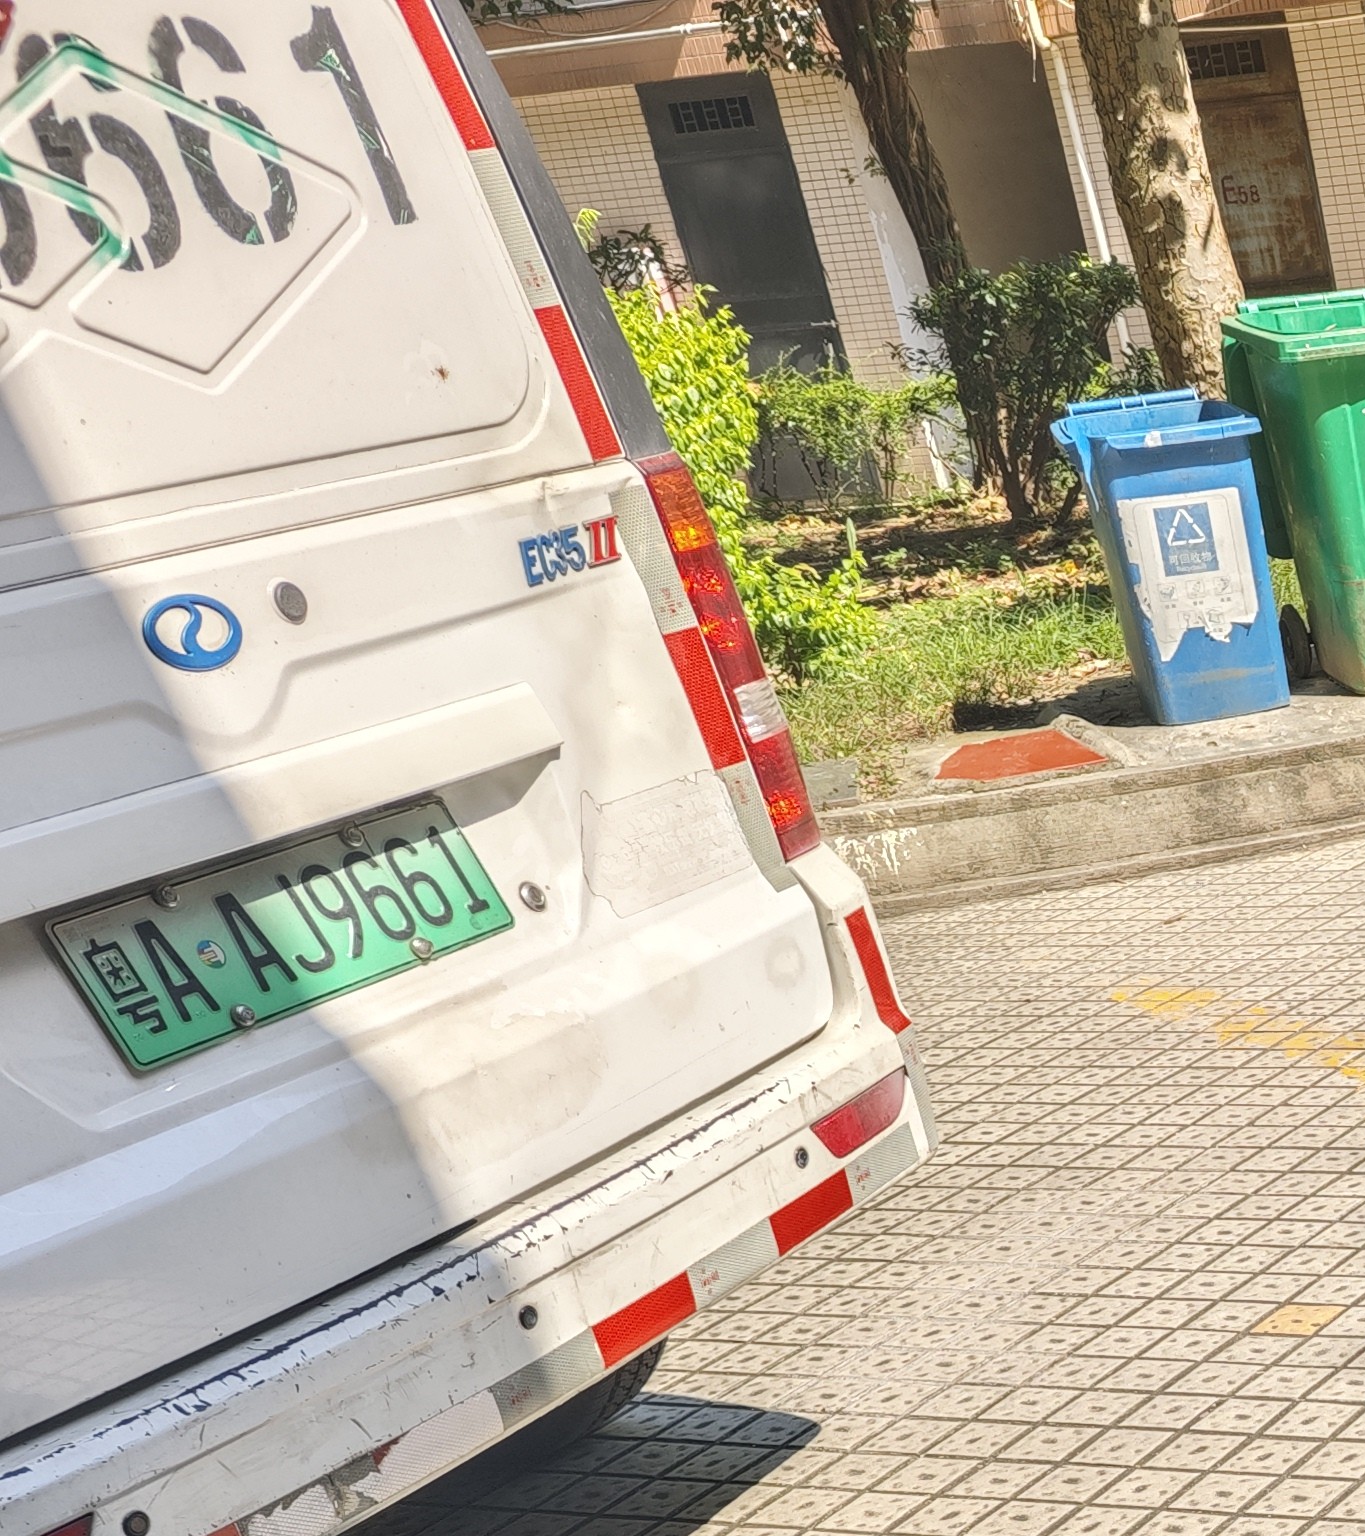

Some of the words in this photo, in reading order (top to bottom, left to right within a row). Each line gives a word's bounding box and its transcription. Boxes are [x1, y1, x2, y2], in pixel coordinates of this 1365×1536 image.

[1221, 174, 1261, 204] E58
[1168, 551, 1213, 567] 可回收物
